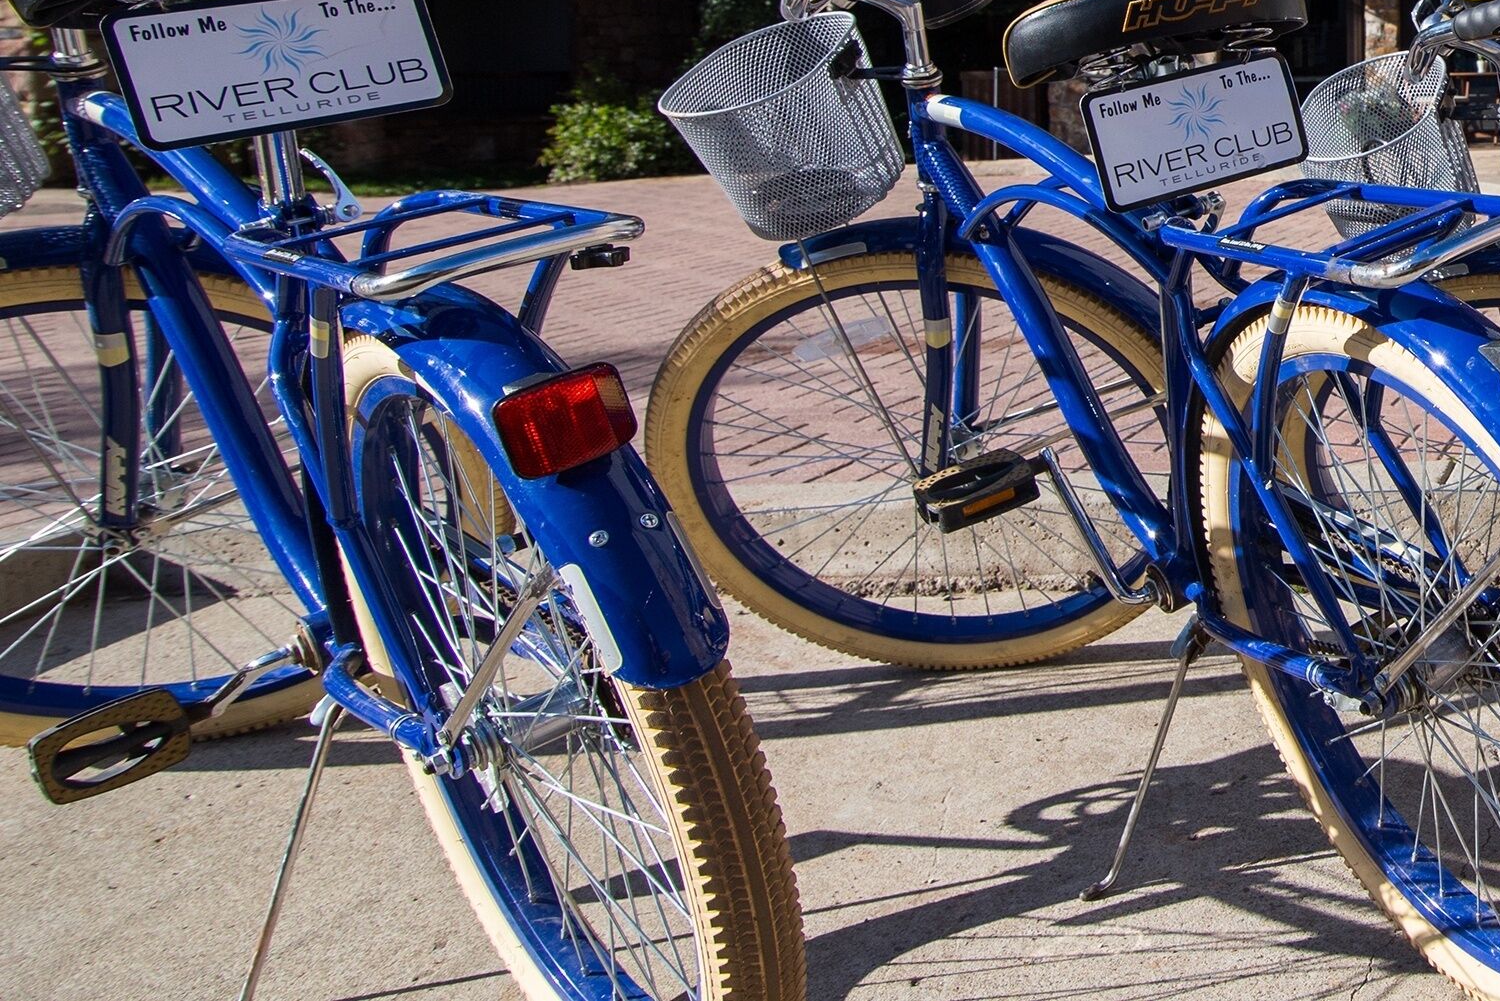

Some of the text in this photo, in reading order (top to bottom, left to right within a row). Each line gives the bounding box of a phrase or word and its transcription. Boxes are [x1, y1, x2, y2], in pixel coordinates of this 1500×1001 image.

[129, 22, 190, 42] Follow
[197, 16, 228, 34] Me
[318, 1, 340, 18] To
[150, 58, 429, 122] RIVER CLUB
[223, 91, 382, 124] TELLURIDE
[1099, 70, 1272, 119] Follow Me To The...
[1113, 121, 1294, 188] RIVER CLUB
[1160, 152, 1261, 187] TELLURIDE
[105, 436, 127, 517] HUFFY
